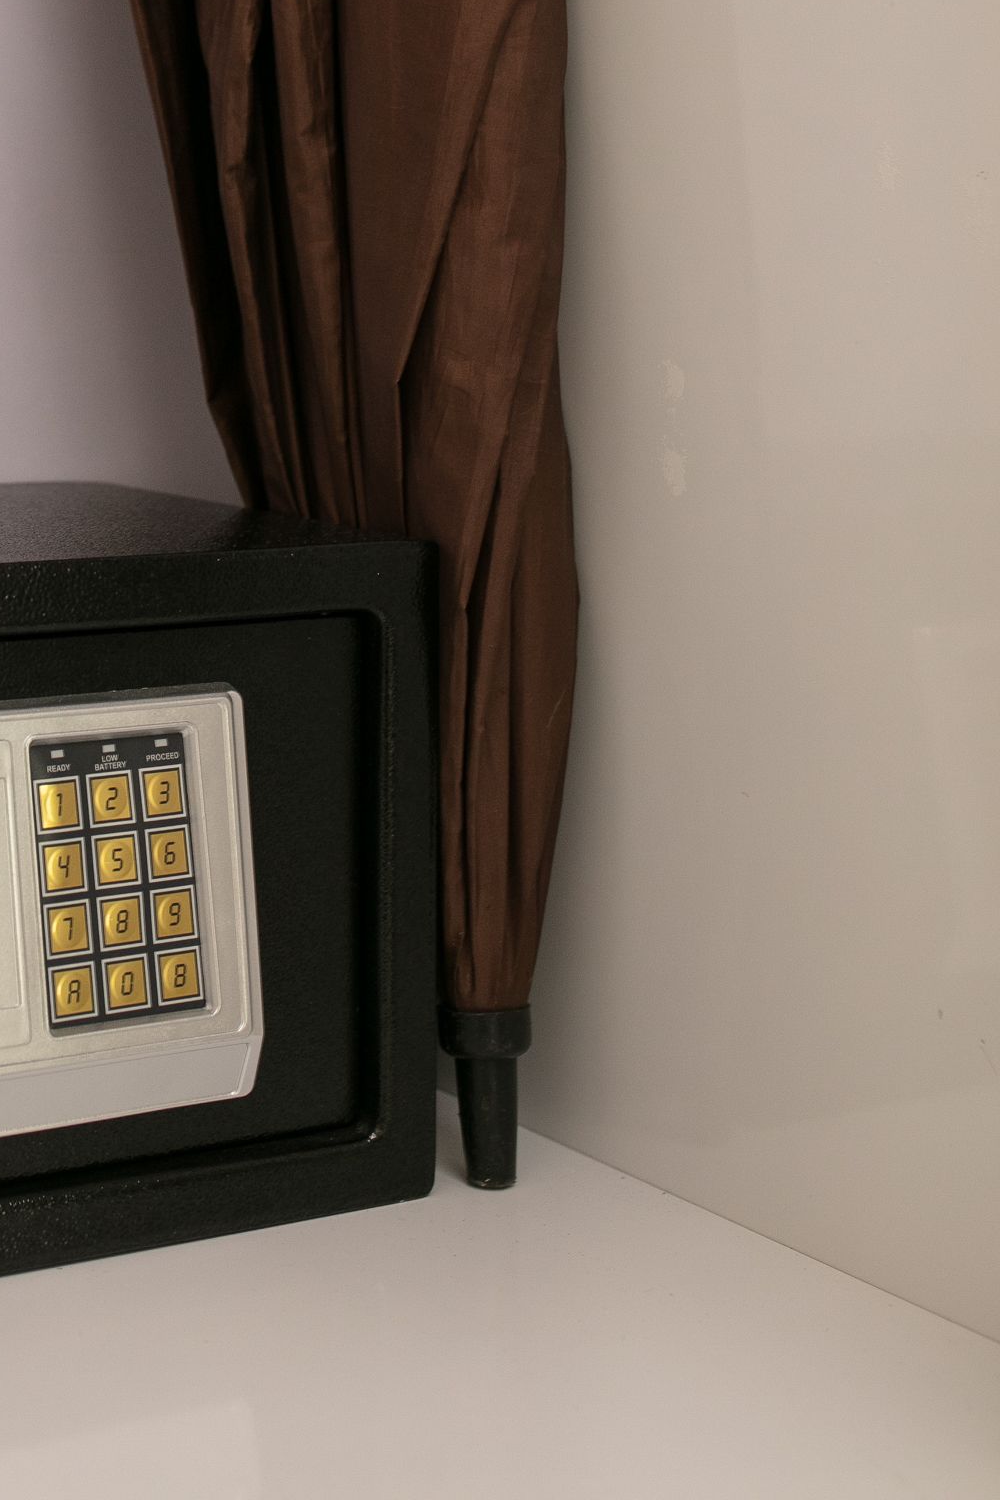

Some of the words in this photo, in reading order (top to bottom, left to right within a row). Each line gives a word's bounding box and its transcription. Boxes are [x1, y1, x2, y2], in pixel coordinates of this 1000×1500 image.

[95, 760, 127, 771] BATTERY
[101, 754, 119, 762] LOW
[146, 752, 180, 762] PROCEED
[46, 764, 71, 773] READY
[56, 793, 63, 816] 1
[106, 787, 118, 810] 2
[159, 781, 170, 804] 3
[58, 855, 70, 877] 4
[112, 848, 123, 872] 5
[164, 841, 175, 865] 6
[63, 917, 73, 940] 7
[116, 910, 128, 933] 8
[169, 902, 180, 926] 9
[68, 980, 80, 1005] A
[121, 972, 134, 995] 0
